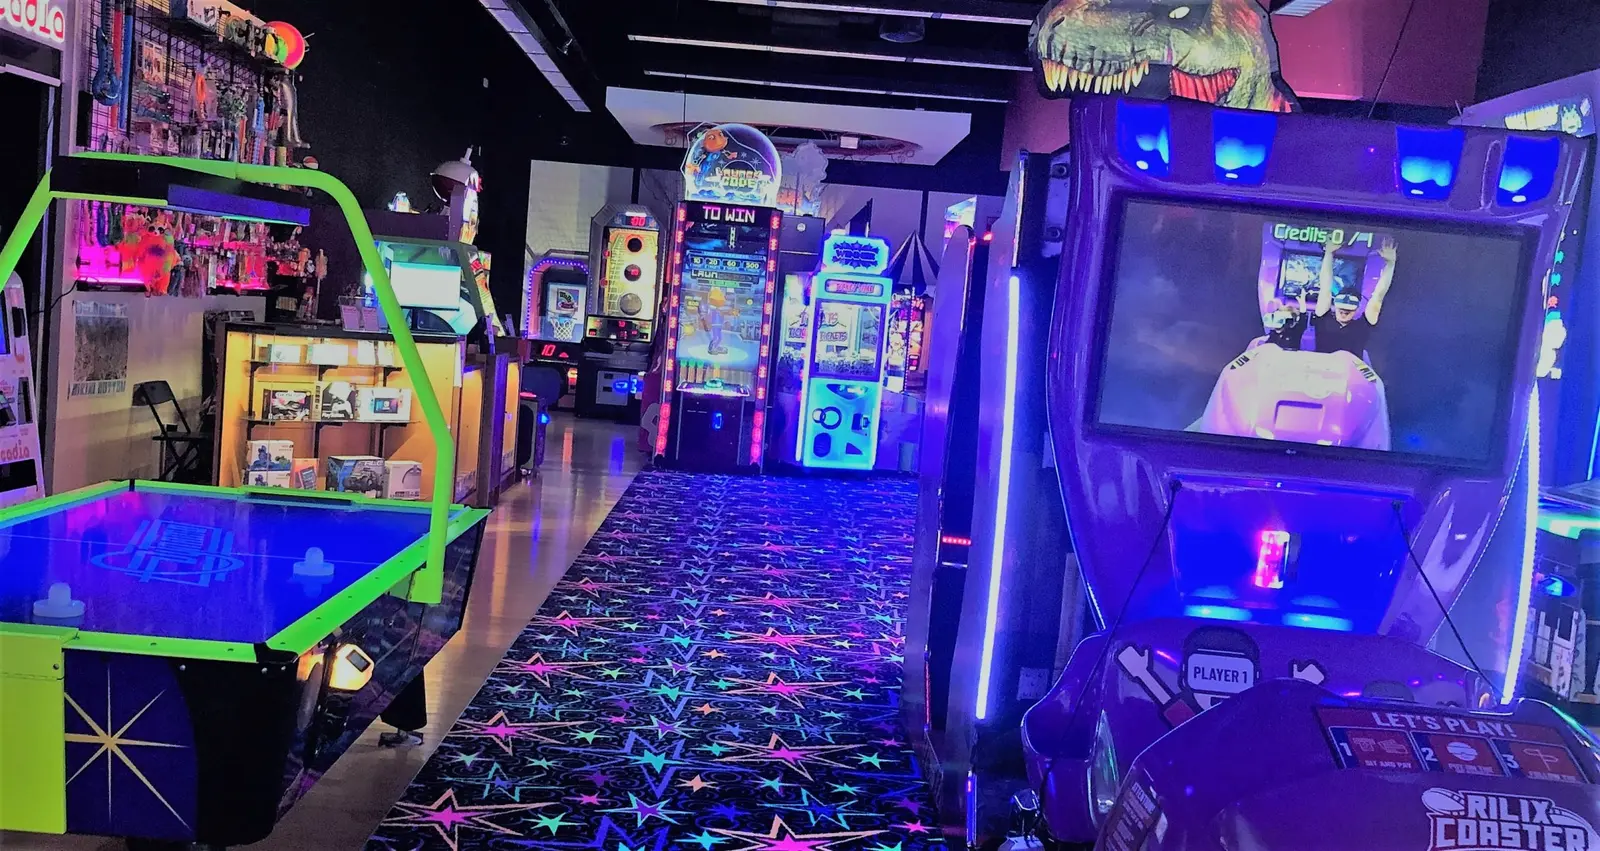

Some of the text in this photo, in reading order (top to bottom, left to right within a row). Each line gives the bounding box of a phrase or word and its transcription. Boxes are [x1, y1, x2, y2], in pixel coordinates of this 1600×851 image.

[722, 176, 756, 188] CODE
[702, 206, 755, 224] TO WIN
[1274, 223, 1327, 244] Credits
[541, 344, 556, 357] 10
[1193, 666, 1248, 684] PLAYER 1
[1372, 711, 1517, 738] LET'S PLAY!
[1339, 742, 1353, 757] 1
[1421, 747, 1439, 762] 2
[1502, 754, 1520, 769] 3
[1467, 794, 1555, 826] RILIX
[1435, 819, 1588, 851] COASTER
